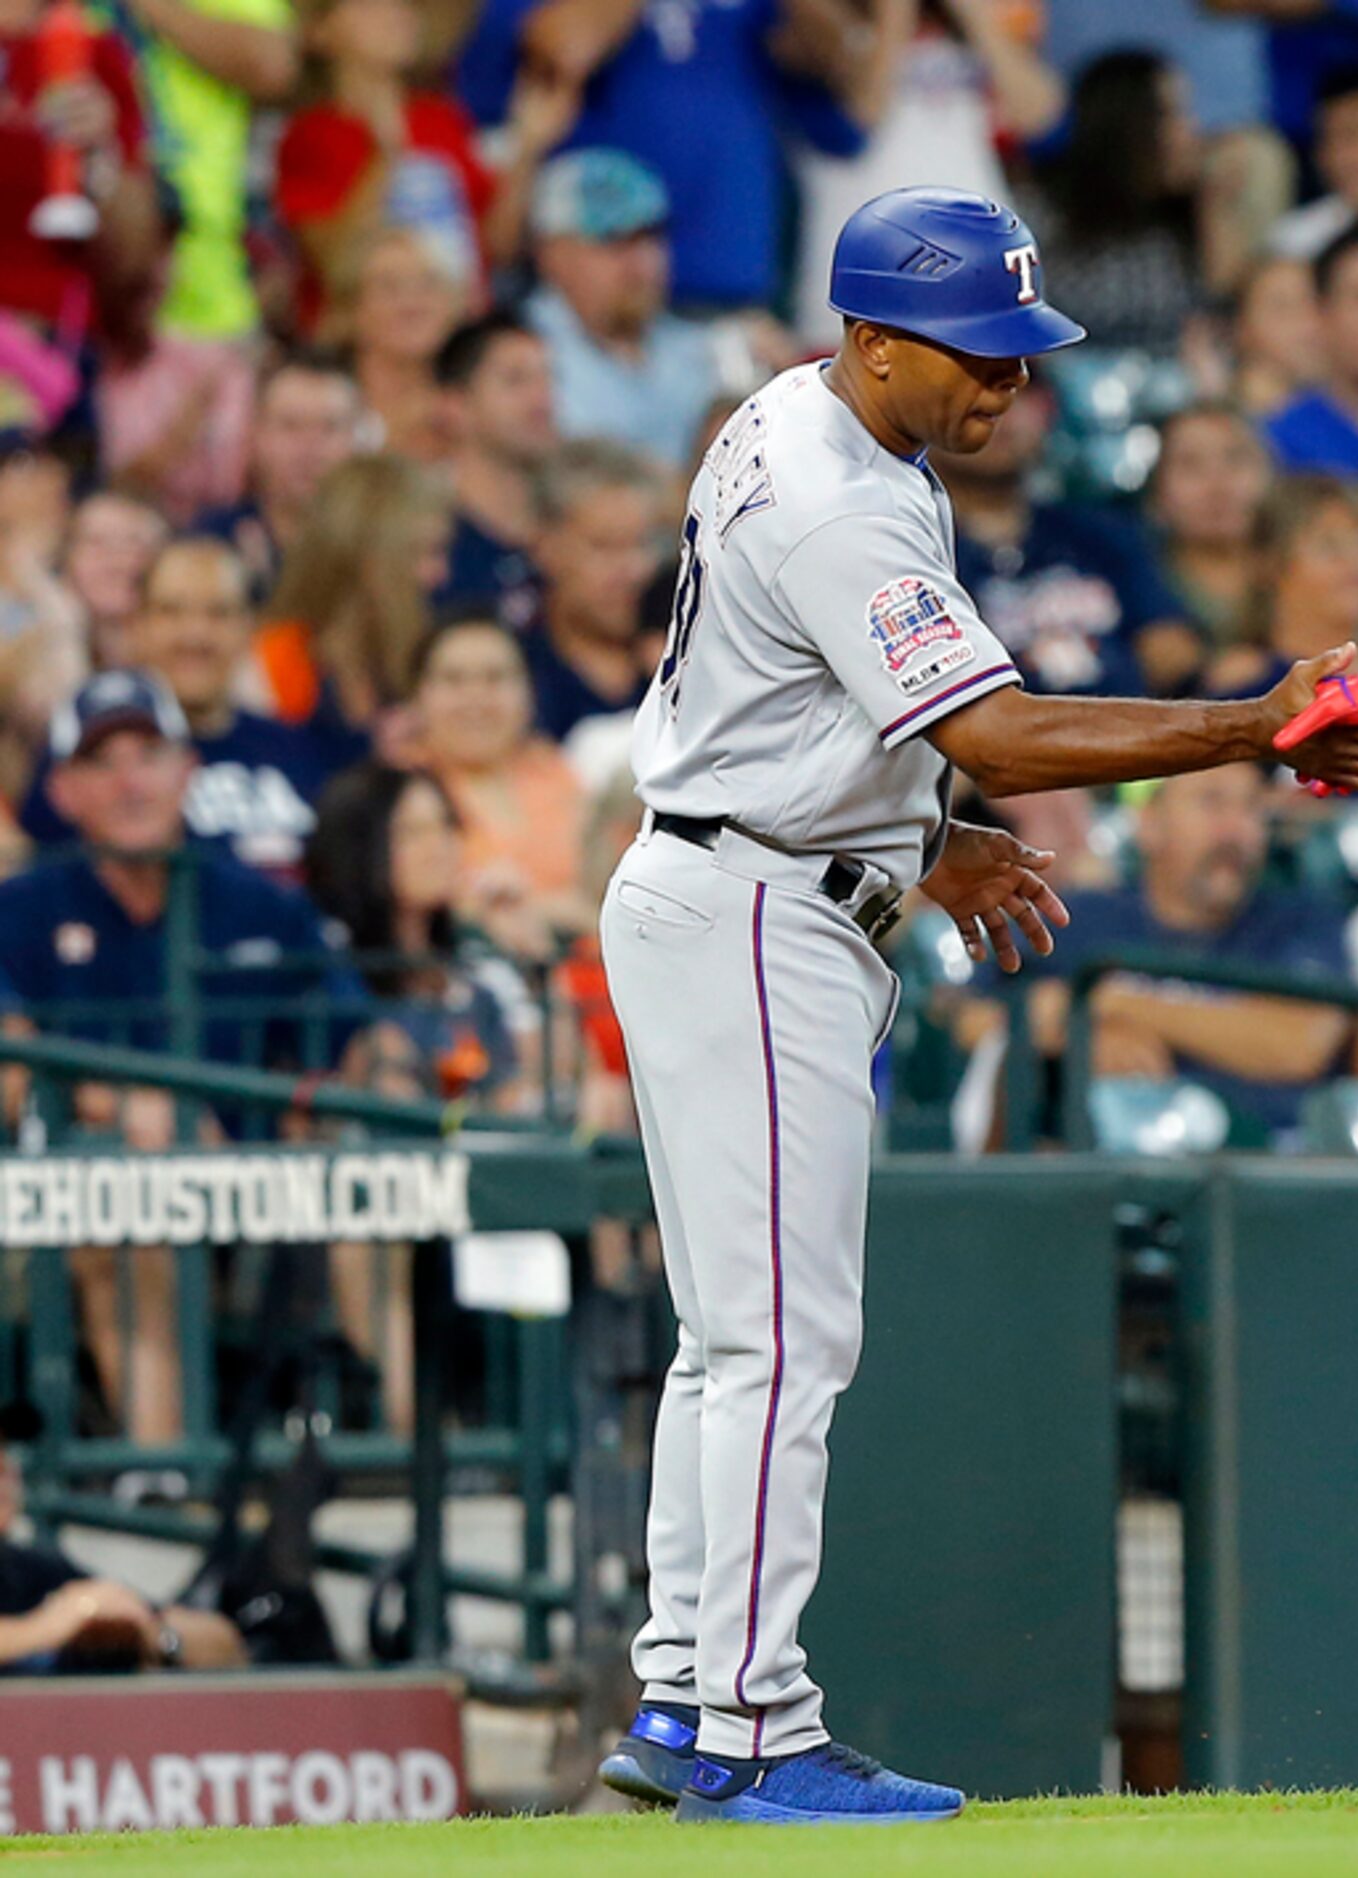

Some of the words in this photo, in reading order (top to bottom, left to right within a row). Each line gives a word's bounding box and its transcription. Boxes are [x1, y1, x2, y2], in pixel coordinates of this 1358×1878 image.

[1004, 245, 1040, 304] T
[901, 667, 931, 690] MLB
[38, 1749, 458, 1834] HARTFORD
